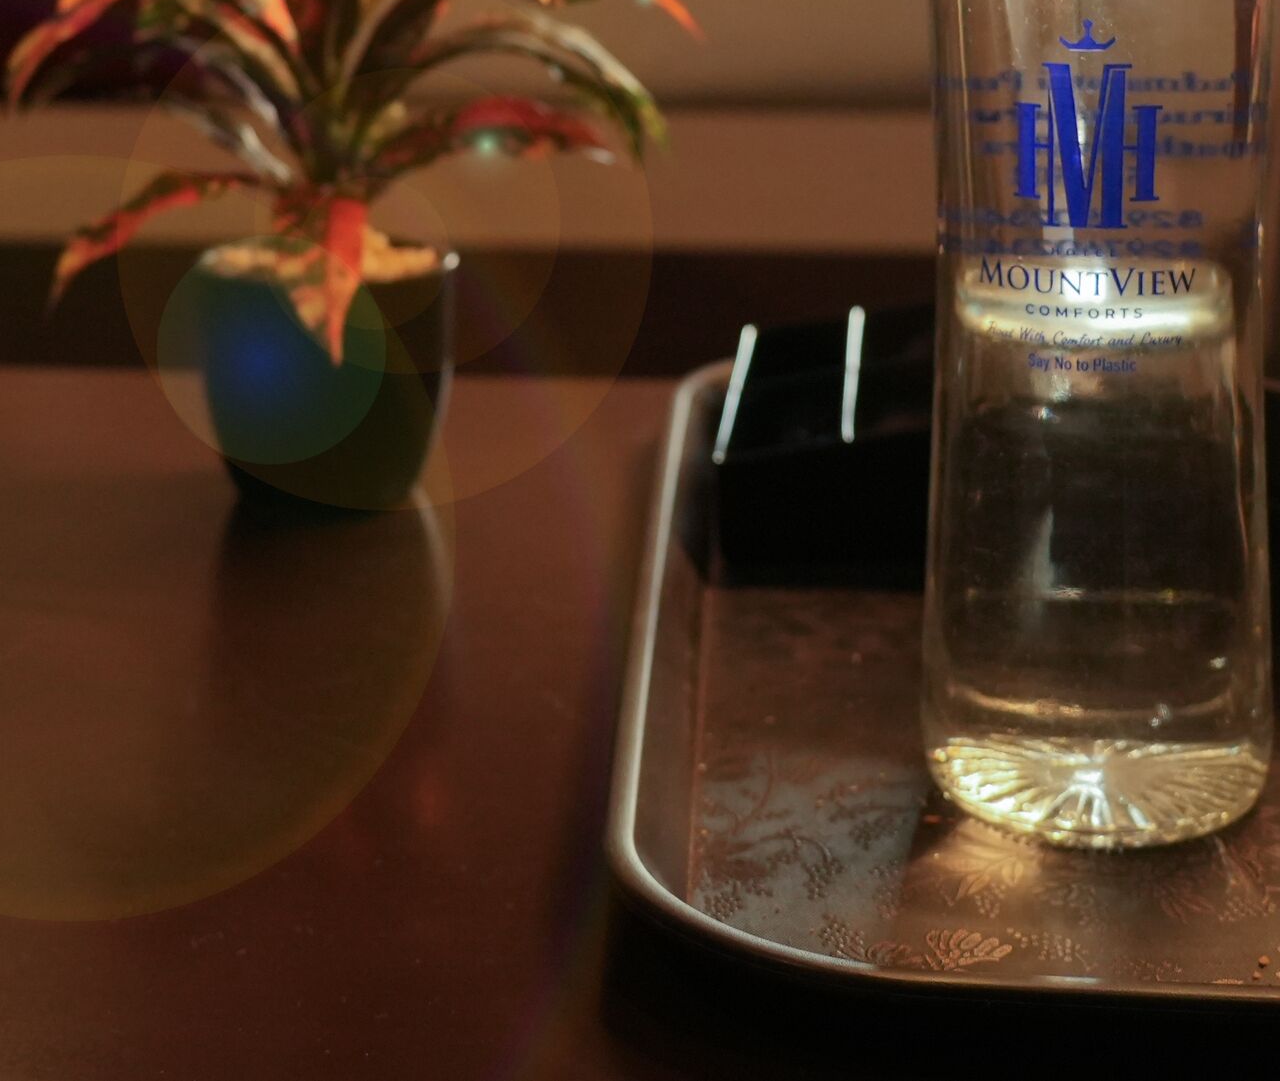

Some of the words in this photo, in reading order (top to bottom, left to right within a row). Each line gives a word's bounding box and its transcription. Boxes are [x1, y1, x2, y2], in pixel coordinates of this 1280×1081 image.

[1025, 303, 1143, 319] COMFORTS
[1019, 326, 1046, 344] With
[1052, 329, 1104, 347] Comfort
[1107, 333, 1134, 346] and
[1139, 331, 1184, 346] Luxury
[1028, 352, 1050, 371] Say
[1054, 355, 1073, 370] No
[1076, 357, 1090, 371] to
[1092, 357, 1137, 371] Plastic
